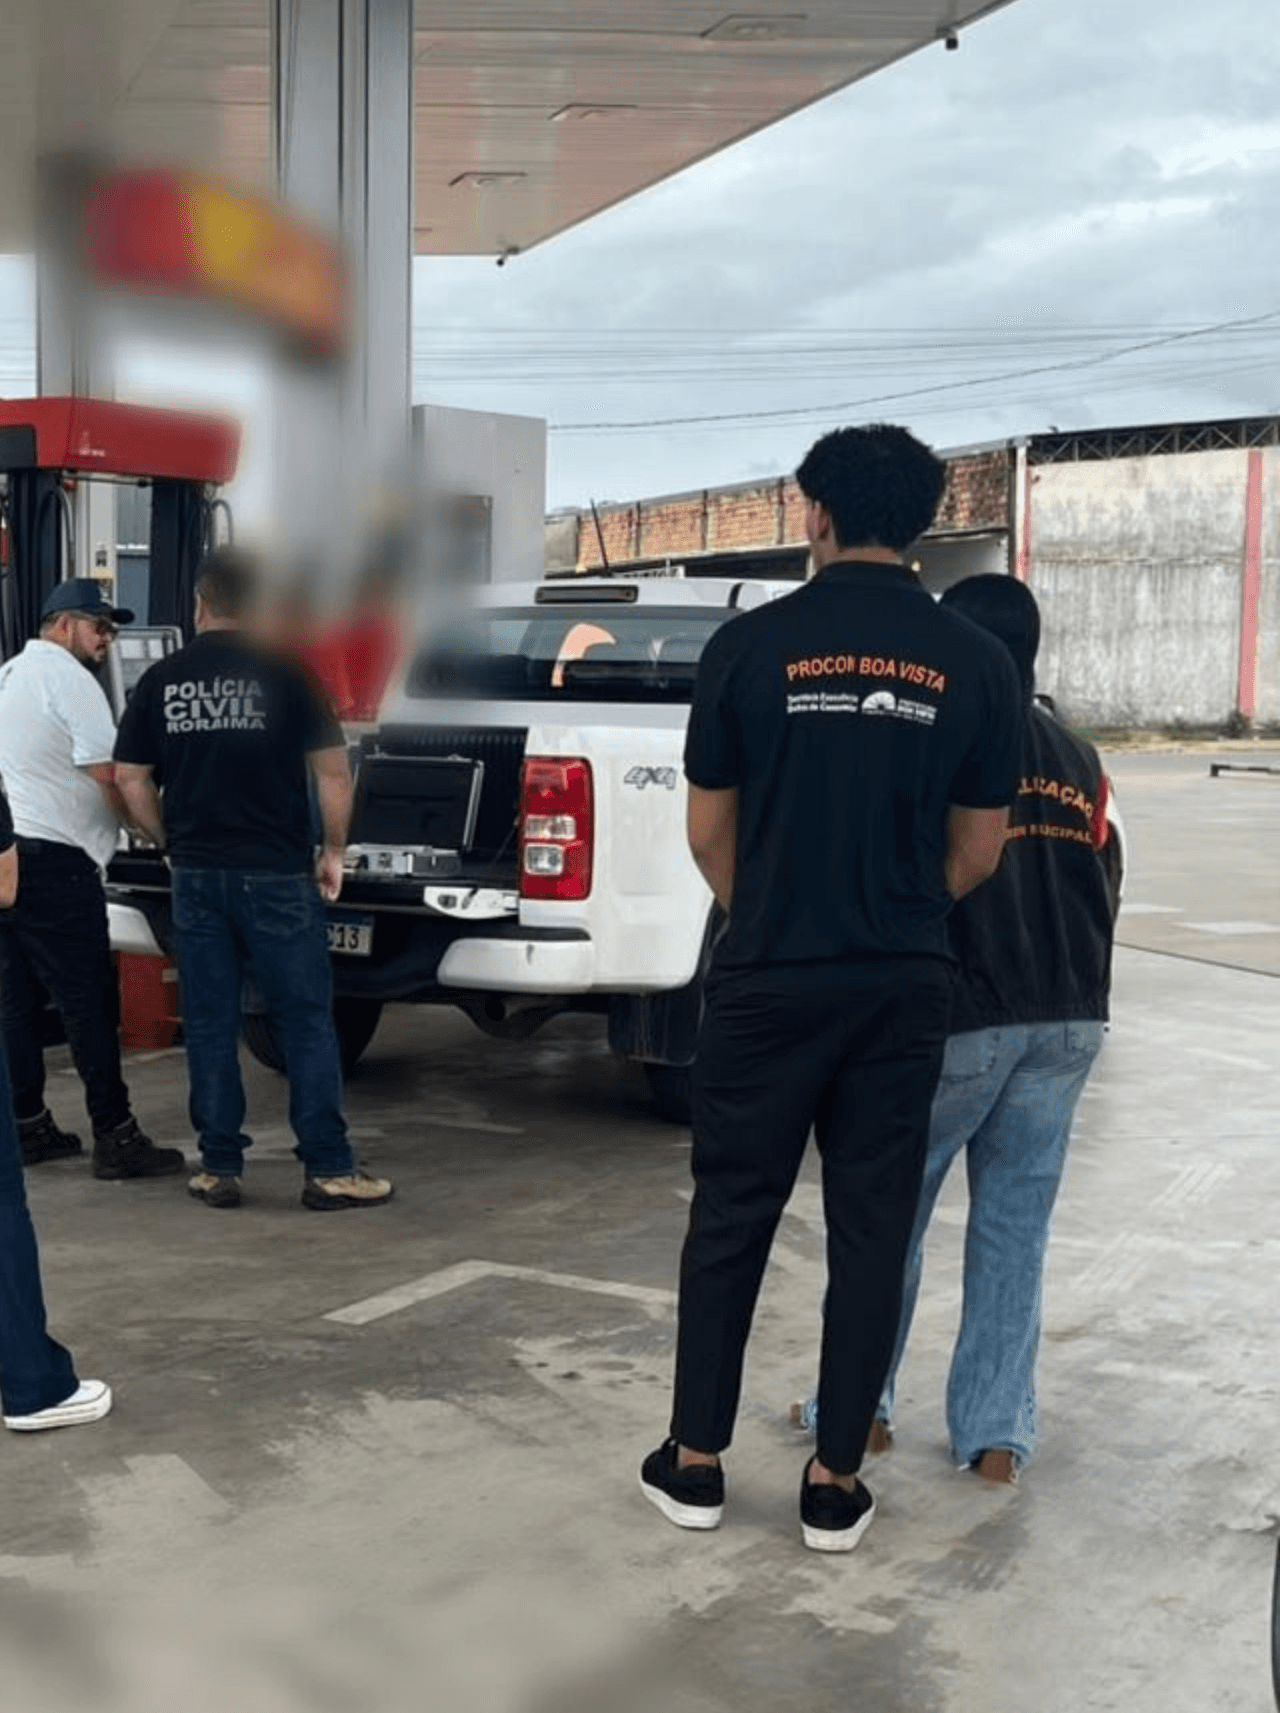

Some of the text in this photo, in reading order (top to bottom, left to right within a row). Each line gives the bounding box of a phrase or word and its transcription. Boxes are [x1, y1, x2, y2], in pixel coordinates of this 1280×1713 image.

[859, 656, 896, 678] BOA
[899, 661, 945, 694] VISTA
[163, 676, 264, 702] POLÍCIA
[163, 698, 266, 721] CIVIL
[165, 716, 266, 734] RORAIMA
